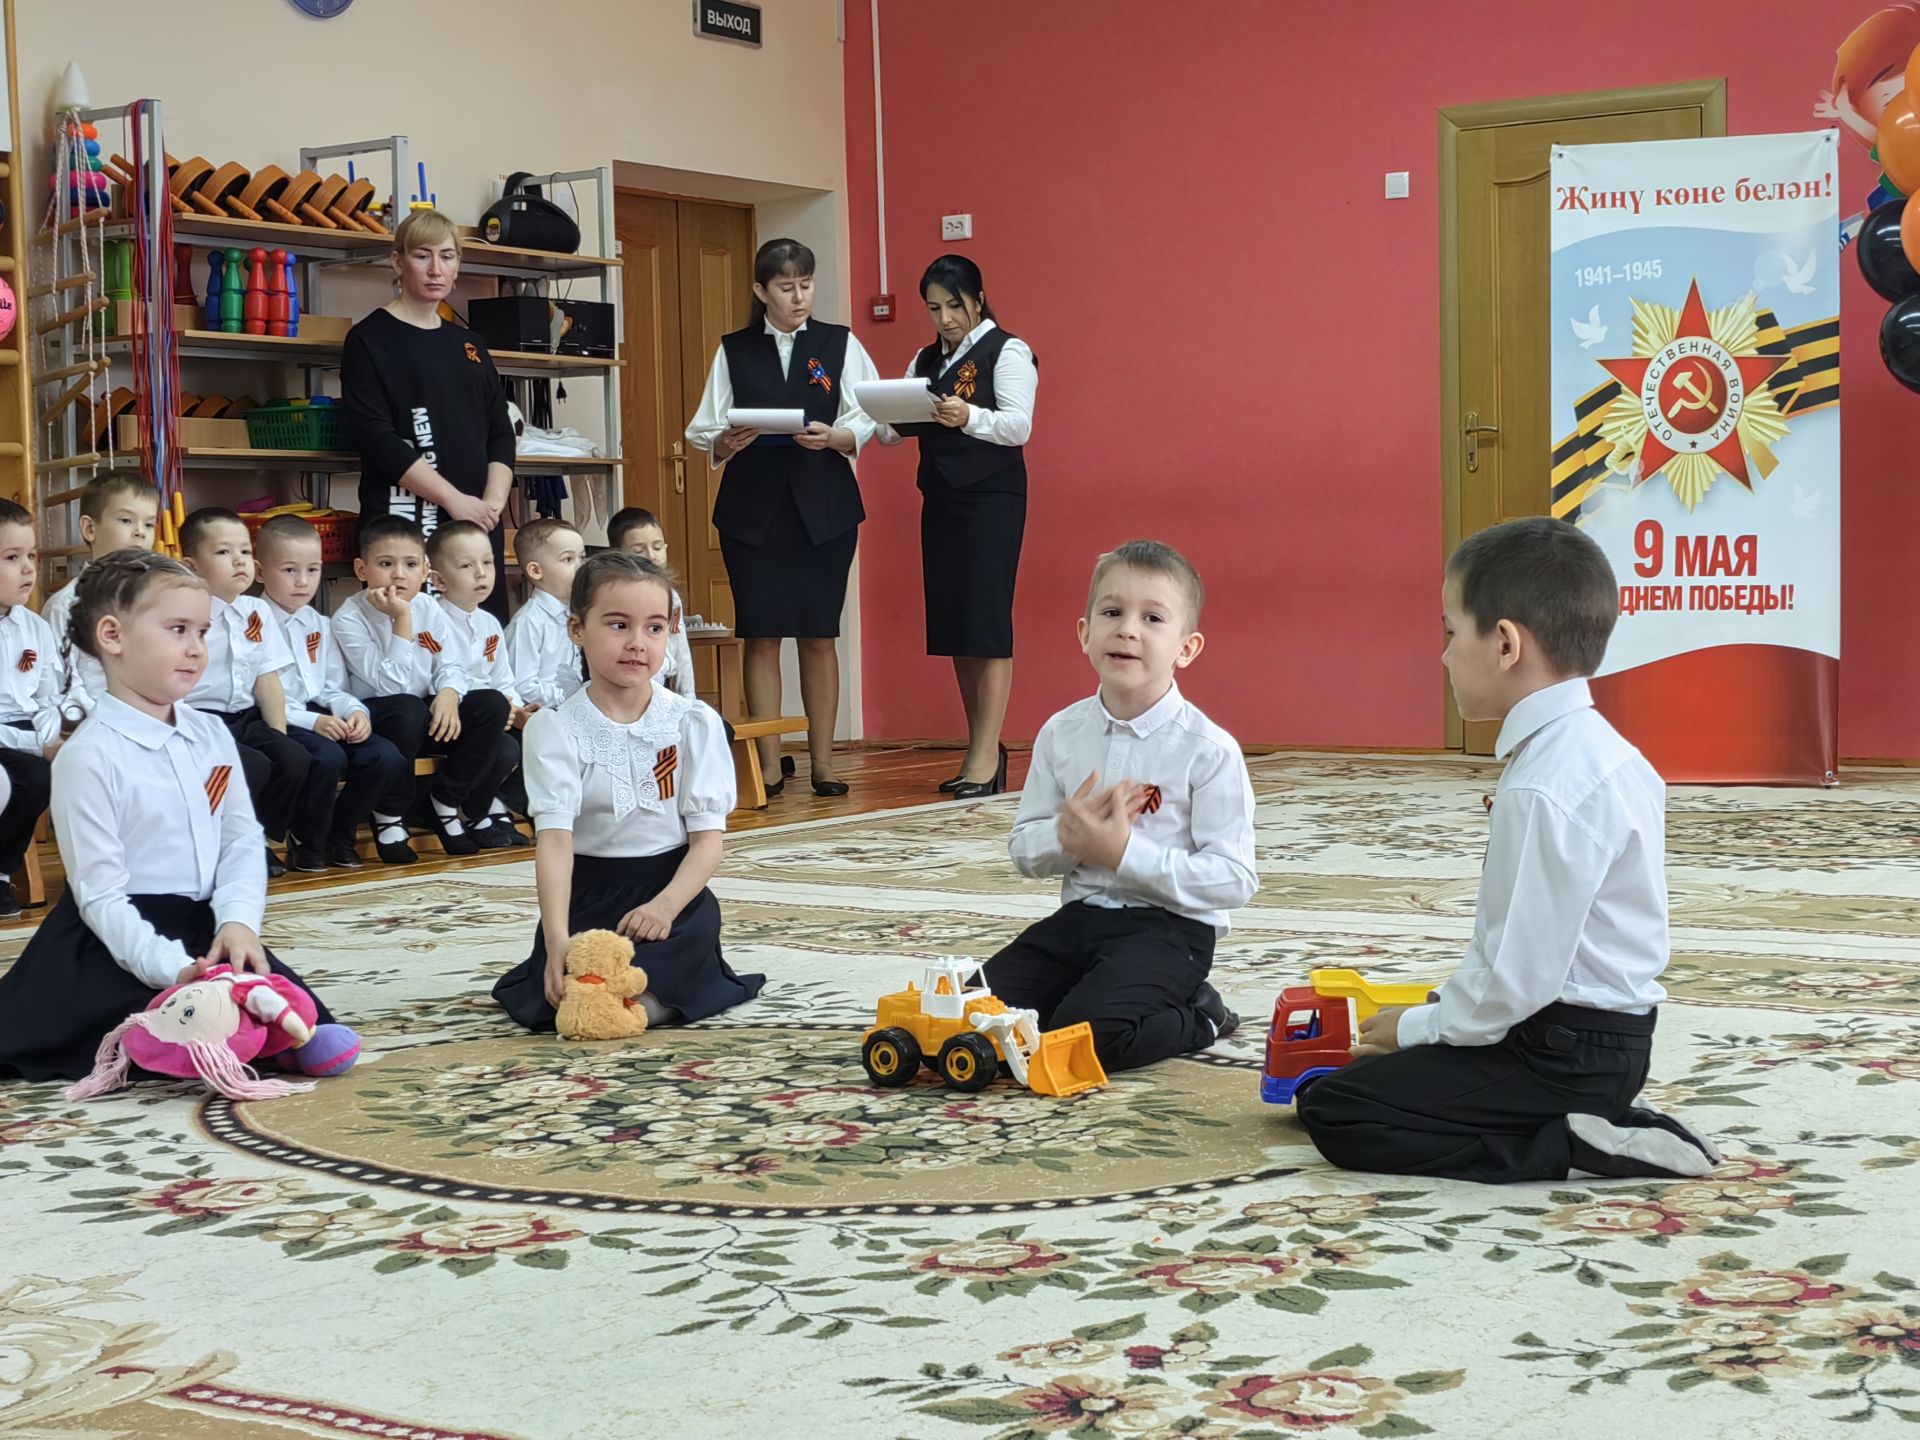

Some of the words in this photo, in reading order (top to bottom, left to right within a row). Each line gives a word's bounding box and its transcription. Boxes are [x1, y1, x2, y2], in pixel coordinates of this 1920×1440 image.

[707, 9, 752, 36] ВЫХОД
[1556, 185, 1644, 215] Җиңү
[1655, 186, 1726, 206] көне
[1735, 172, 1832, 203] белән!
[1645, 341, 1732, 441] ОТЕЧЕСТВЕННАЯ
[411, 407, 434, 448] NEW
[1633, 519, 1664, 578] 9
[1674, 534, 1758, 577] МАЯ
[1617, 585, 1683, 616] ДНЕМ
[1689, 584, 1795, 616] ПОБЕДЫ!
